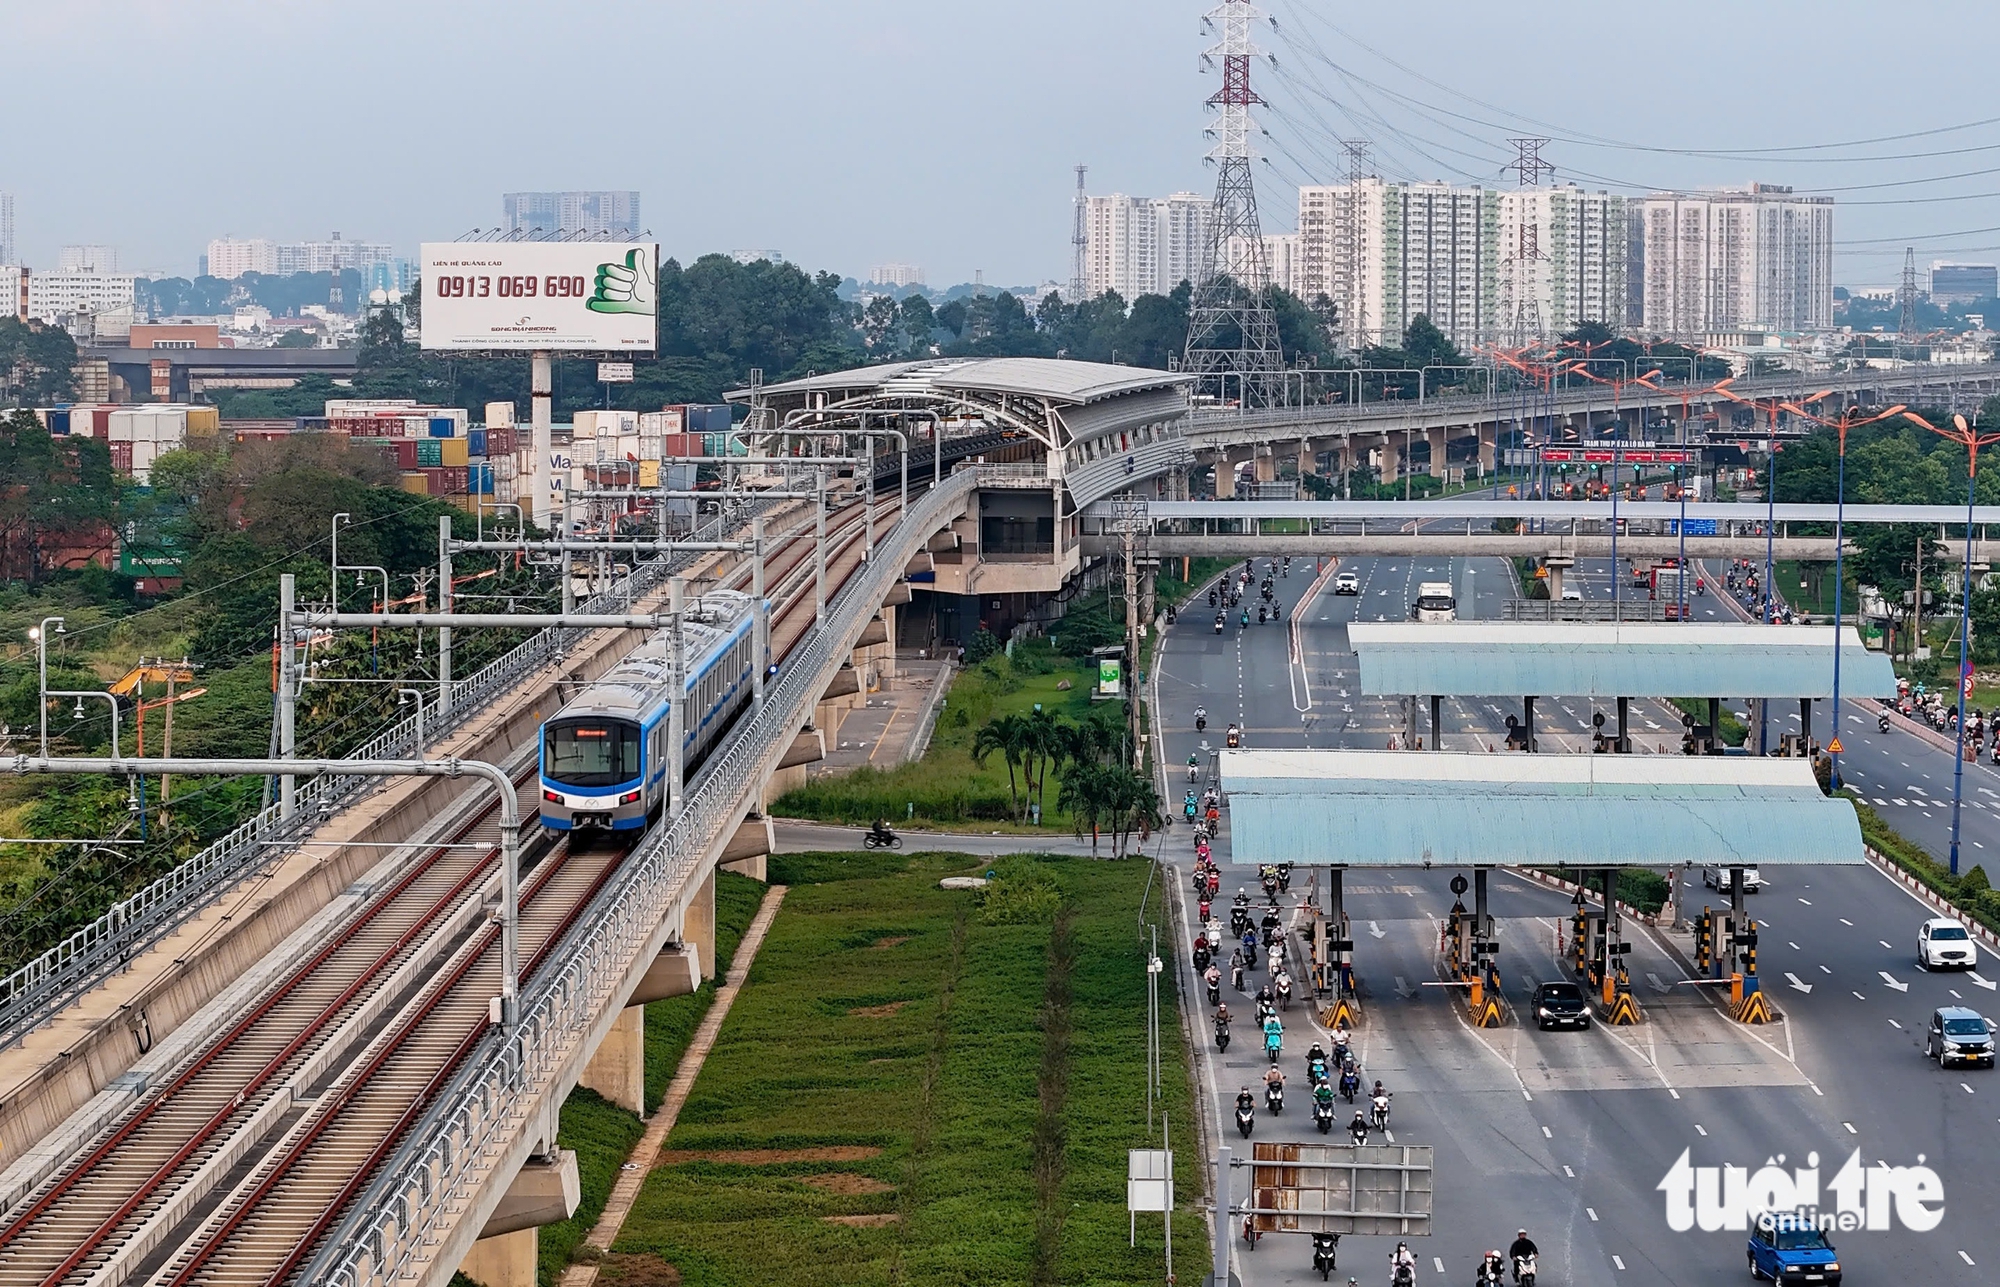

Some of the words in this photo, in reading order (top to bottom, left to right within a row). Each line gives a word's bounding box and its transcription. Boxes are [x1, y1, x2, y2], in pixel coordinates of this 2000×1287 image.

[437, 276, 490, 298] 0913
[497, 276, 537, 298] 069
[544, 276, 585, 298] 690
